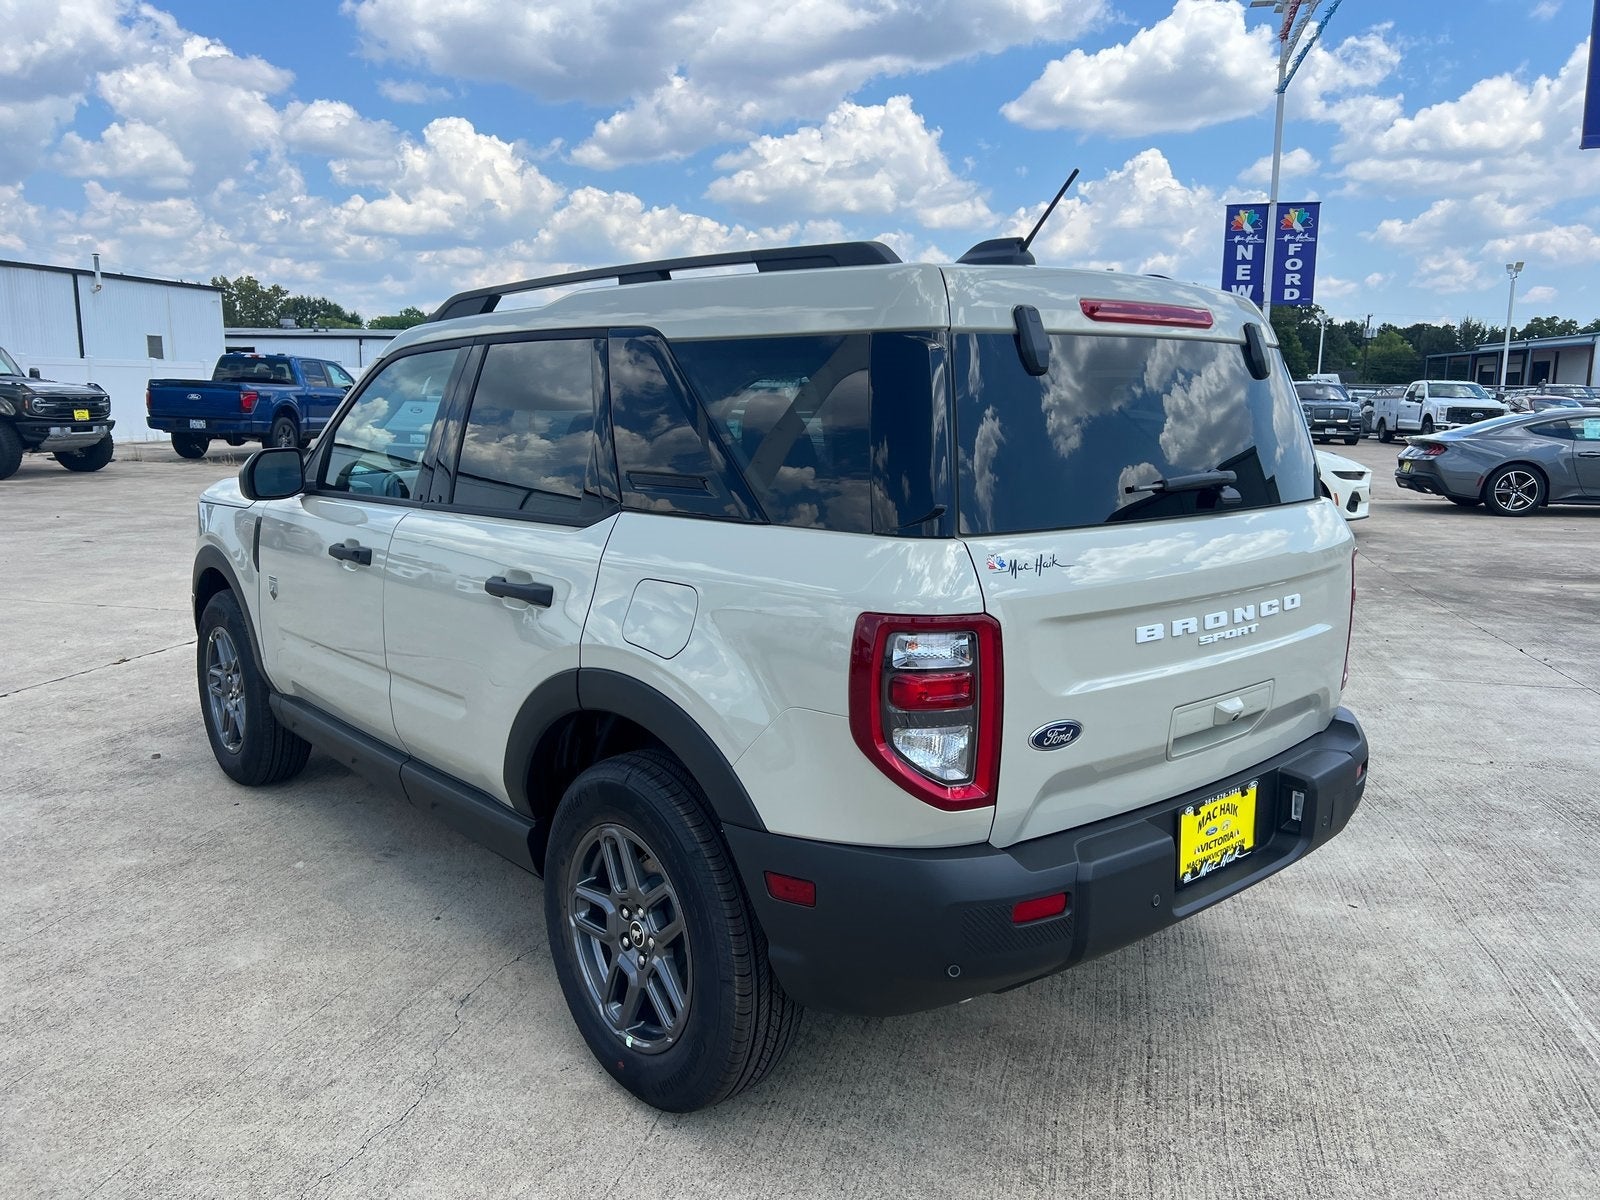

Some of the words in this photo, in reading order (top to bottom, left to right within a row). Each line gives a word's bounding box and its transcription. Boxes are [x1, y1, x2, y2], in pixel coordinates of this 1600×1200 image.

[1230, 244, 1254, 299] NEW
[1283, 243, 1303, 301] FORD
[1001, 559, 1033, 579] Mac
[1035, 554, 1068, 576] Haik
[1136, 593, 1301, 644] BRONCO
[1199, 623, 1259, 645] SPORT
[1043, 726, 1074, 746] Ford
[1197, 806, 1218, 834] MAC
[1219, 803, 1239, 817] HAIK
[1200, 831, 1234, 853] VICTORIA
[1198, 859, 1220, 877] Mac
[1220, 845, 1248, 867] Haik
